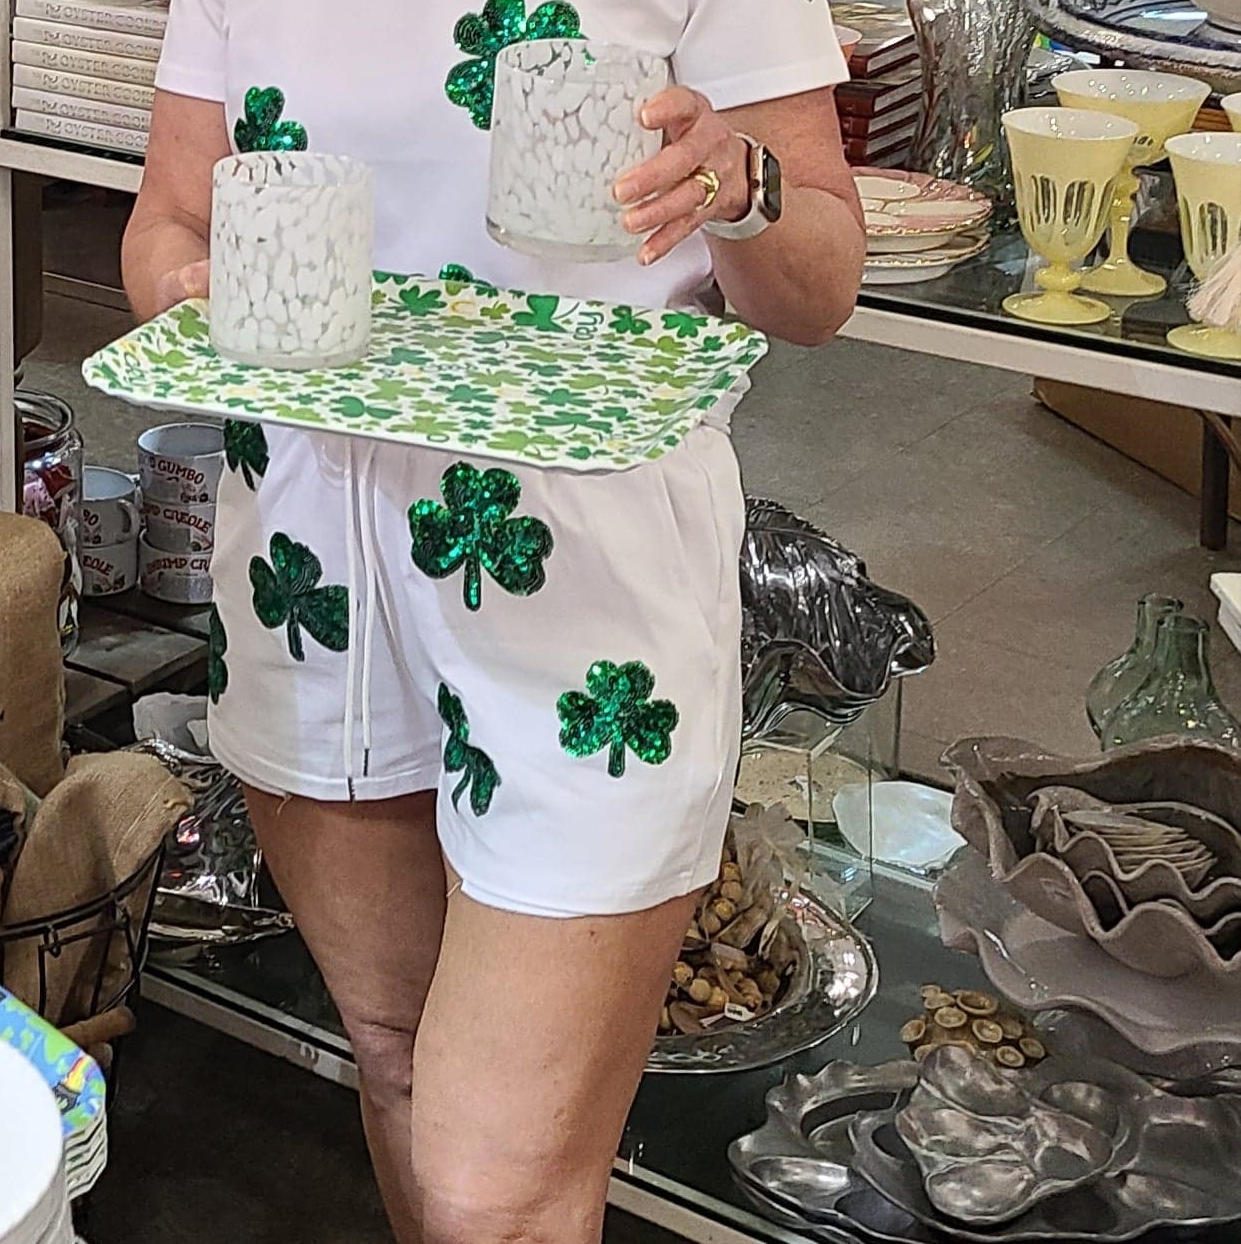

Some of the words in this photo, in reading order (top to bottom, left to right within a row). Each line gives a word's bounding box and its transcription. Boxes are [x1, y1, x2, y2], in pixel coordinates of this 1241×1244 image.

[158, 459, 205, 485] GUMBO
[163, 508, 212, 534] CREOLE
[83, 555, 114, 576] EOLE
